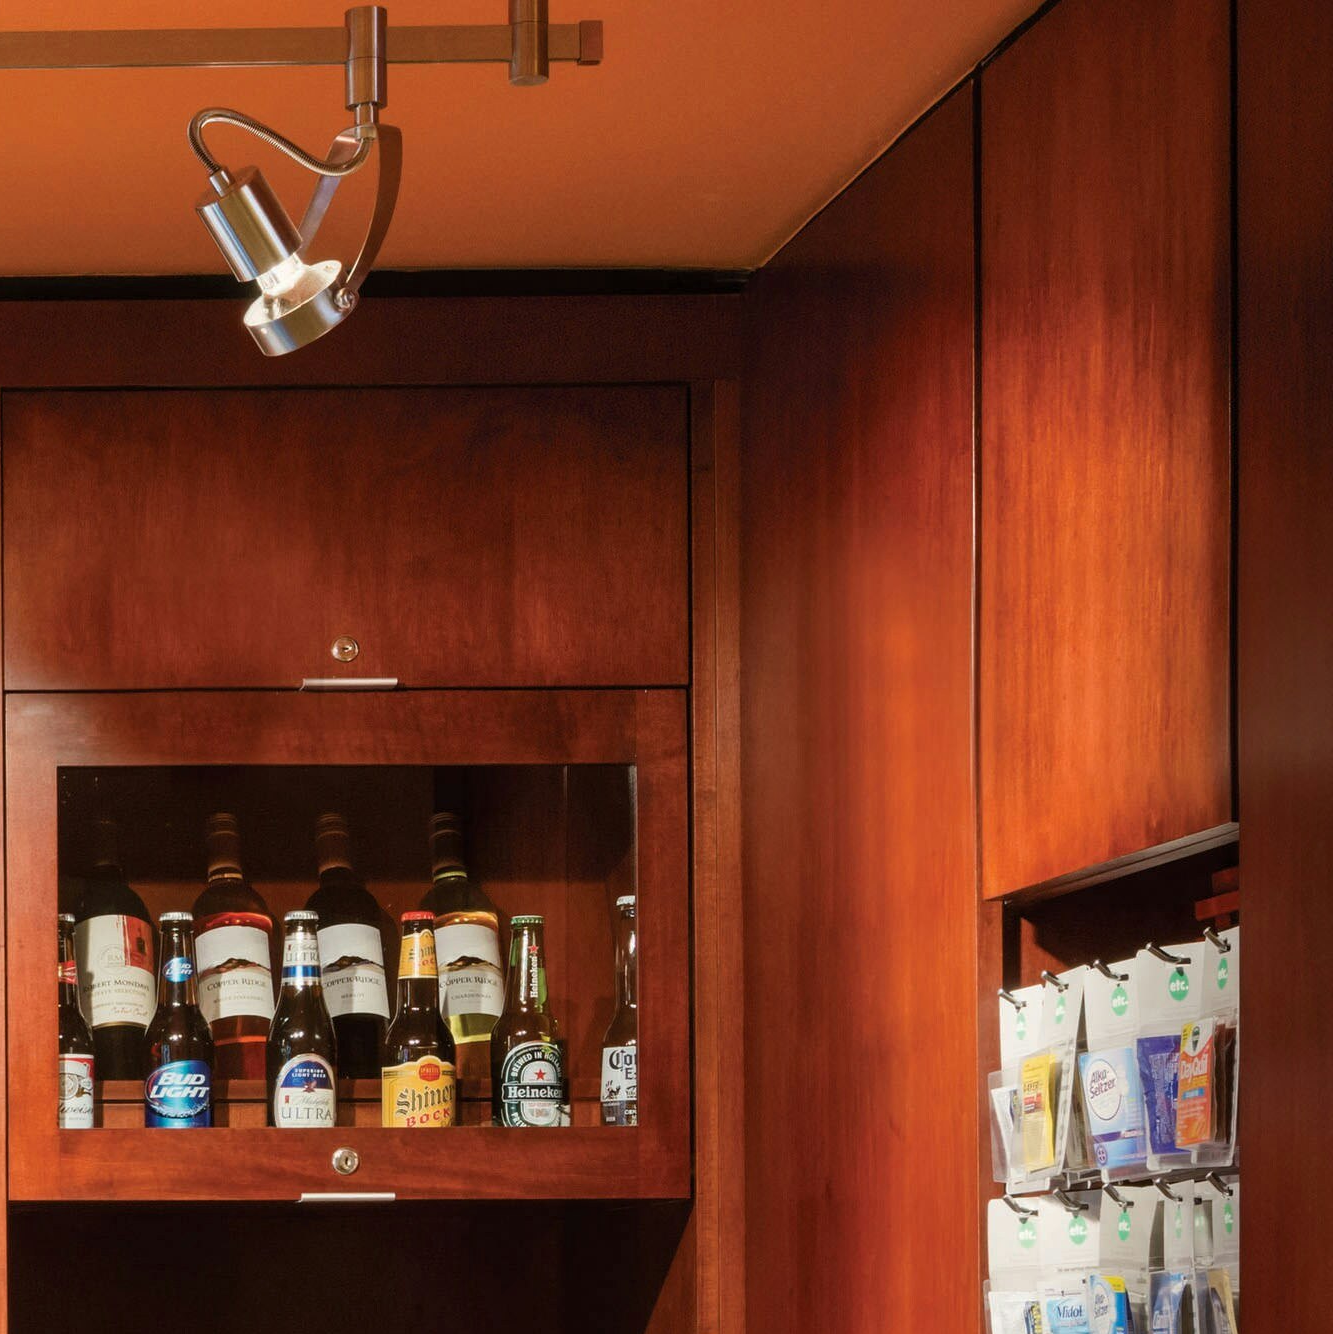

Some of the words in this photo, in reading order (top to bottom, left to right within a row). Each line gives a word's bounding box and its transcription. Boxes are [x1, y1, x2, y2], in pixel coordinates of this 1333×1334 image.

[207, 979, 238, 991] COPPER
[241, 978, 267, 986] RIDGE
[355, 976, 382, 986] RIDGE
[510, 1053, 533, 1077] BREWED
[159, 1072, 205, 1085] BUD
[1091, 1071, 1109, 1084] Alka-
[150, 1086, 209, 1099] LIGHT
[508, 1085, 562, 1098] Heineken
[1090, 1079, 1116, 1099] Seltzer
[397, 1082, 455, 1116] Shiner
[281, 1108, 333, 1120] ULTRA
[406, 1108, 450, 1127] BOCK
[1057, 1304, 1083, 1318] Midol
